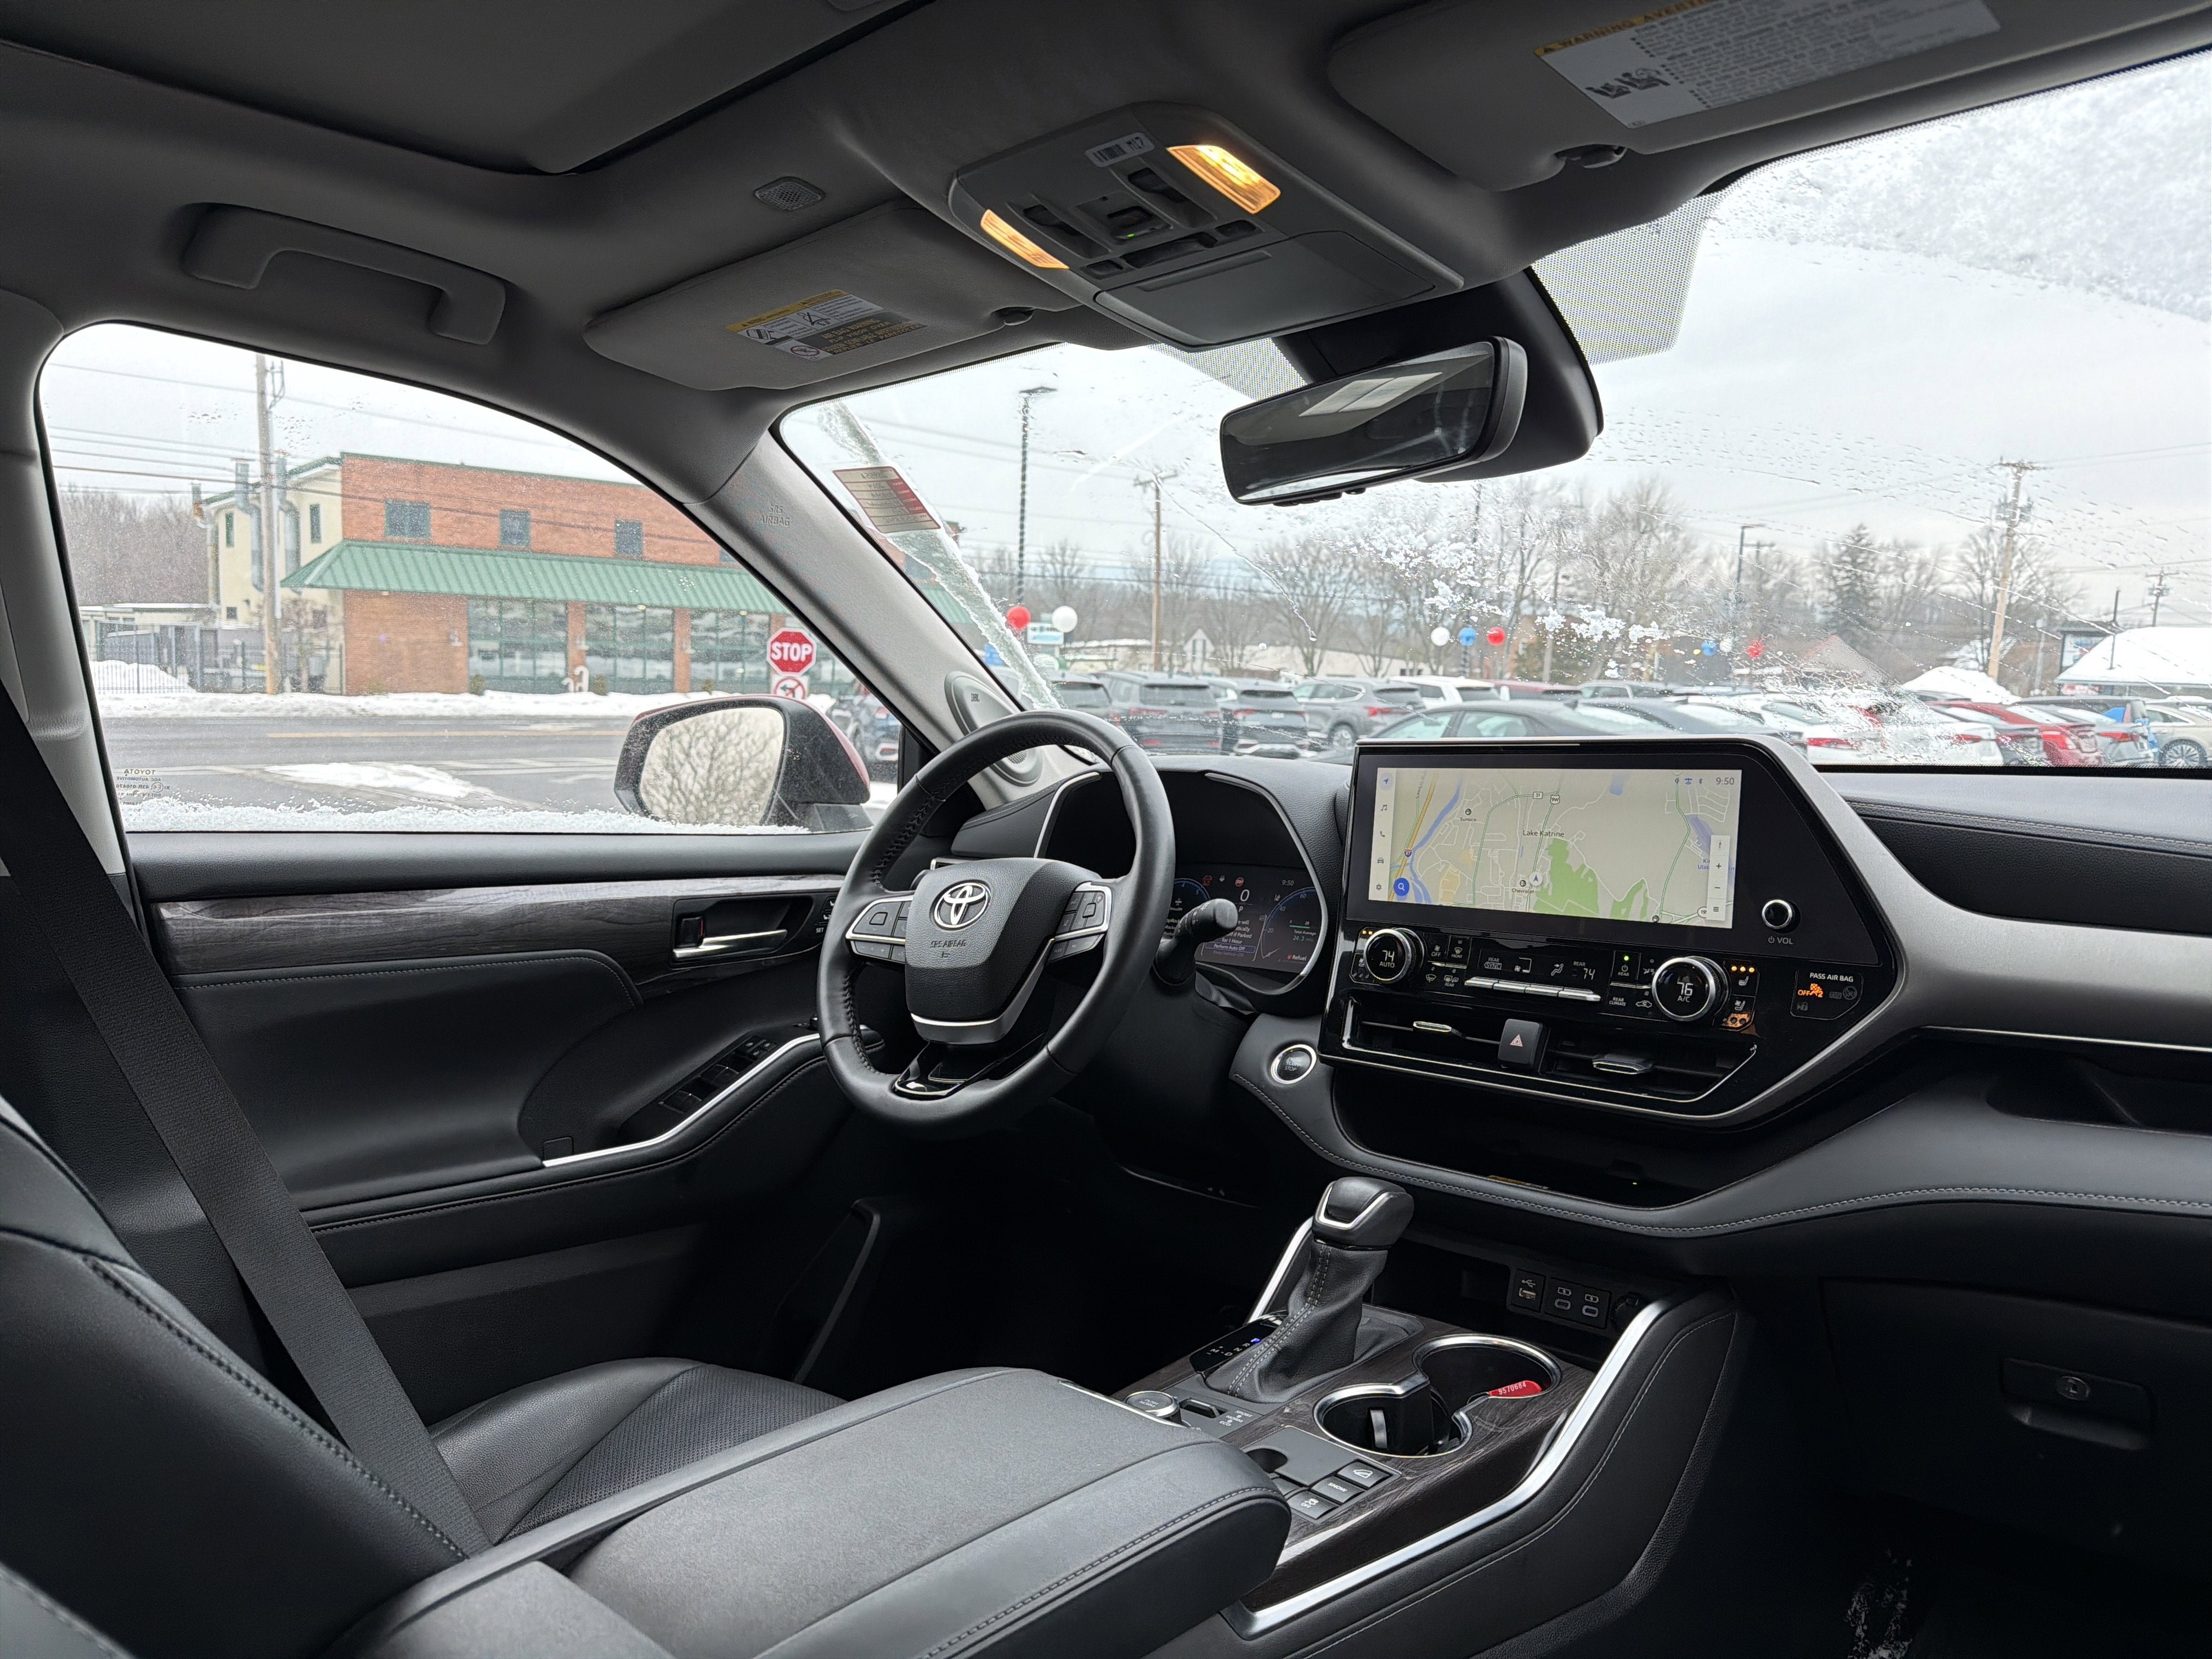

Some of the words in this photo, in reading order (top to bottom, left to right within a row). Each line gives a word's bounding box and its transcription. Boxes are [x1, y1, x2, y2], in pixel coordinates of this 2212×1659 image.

[847, 328, 868, 338] VISOR
[870, 321, 892, 330] OVER
[768, 505, 783, 514] SRS
[759, 515, 790, 526] AIRBAG
[771, 641, 812, 662] STOP
[970, 693, 980, 702] JBL
[1240, 889, 1250, 902] 0
[943, 940, 967, 948] AIRBAG
[1777, 936, 1793, 945] VOL
[1382, 950, 1395, 962] 74
[1583, 967, 1596, 980] 74
[1677, 981, 1694, 996] 76
[1498, 1381, 1527, 1395] 9570684
[1327, 1482, 1347, 1493] SNOW
